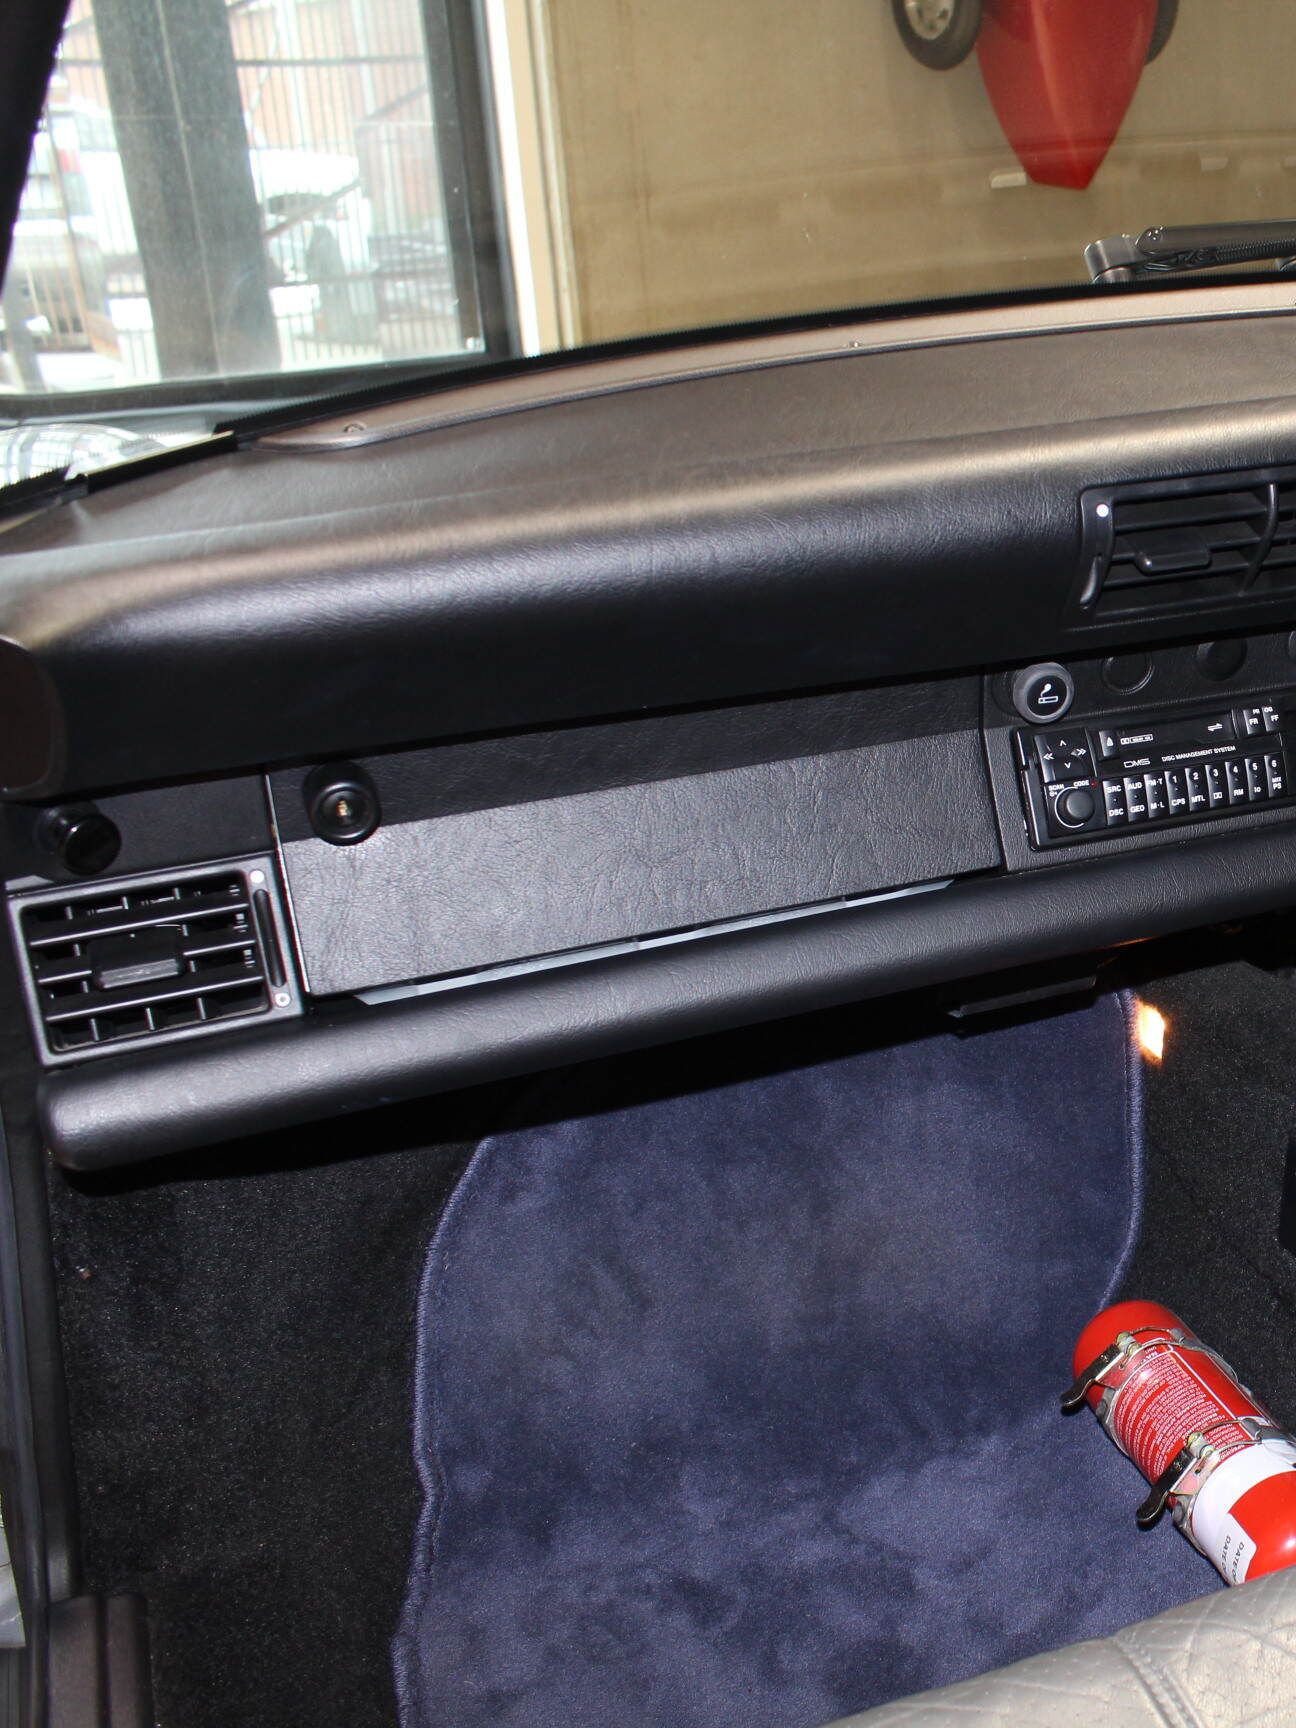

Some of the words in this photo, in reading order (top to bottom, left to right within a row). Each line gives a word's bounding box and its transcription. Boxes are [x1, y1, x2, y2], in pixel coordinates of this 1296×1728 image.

[1161, 755, 1175, 763] DISC
[1175, 749, 1213, 761] MANAGEMENT
[1213, 745, 1236, 754] SYSTEM
[1123, 758, 1151, 768] DMS
[1252, 762, 1258, 771] 5
[1271, 760, 1277, 768] 6
[1212, 768, 1219, 777] 3
[1232, 765, 1239, 773] 4
[1173, 775, 1178, 784] 1
[1192, 772, 1199, 780] 2
[1048, 783, 1065, 791] SCAN
[1106, 785, 1121, 793] SRC
[1127, 782, 1142, 790] AUD
[1272, 782, 1282, 790] PS
[1233, 788, 1244, 796] RM
[1171, 798, 1186, 807] CPS
[1191, 794, 1206, 803] MTL
[1108, 808, 1124, 817] DSC
[1130, 804, 1145, 813] GEO
[1222, 1535, 1231, 1562] DATE
[1233, 1541, 1244, 1569] DATE
